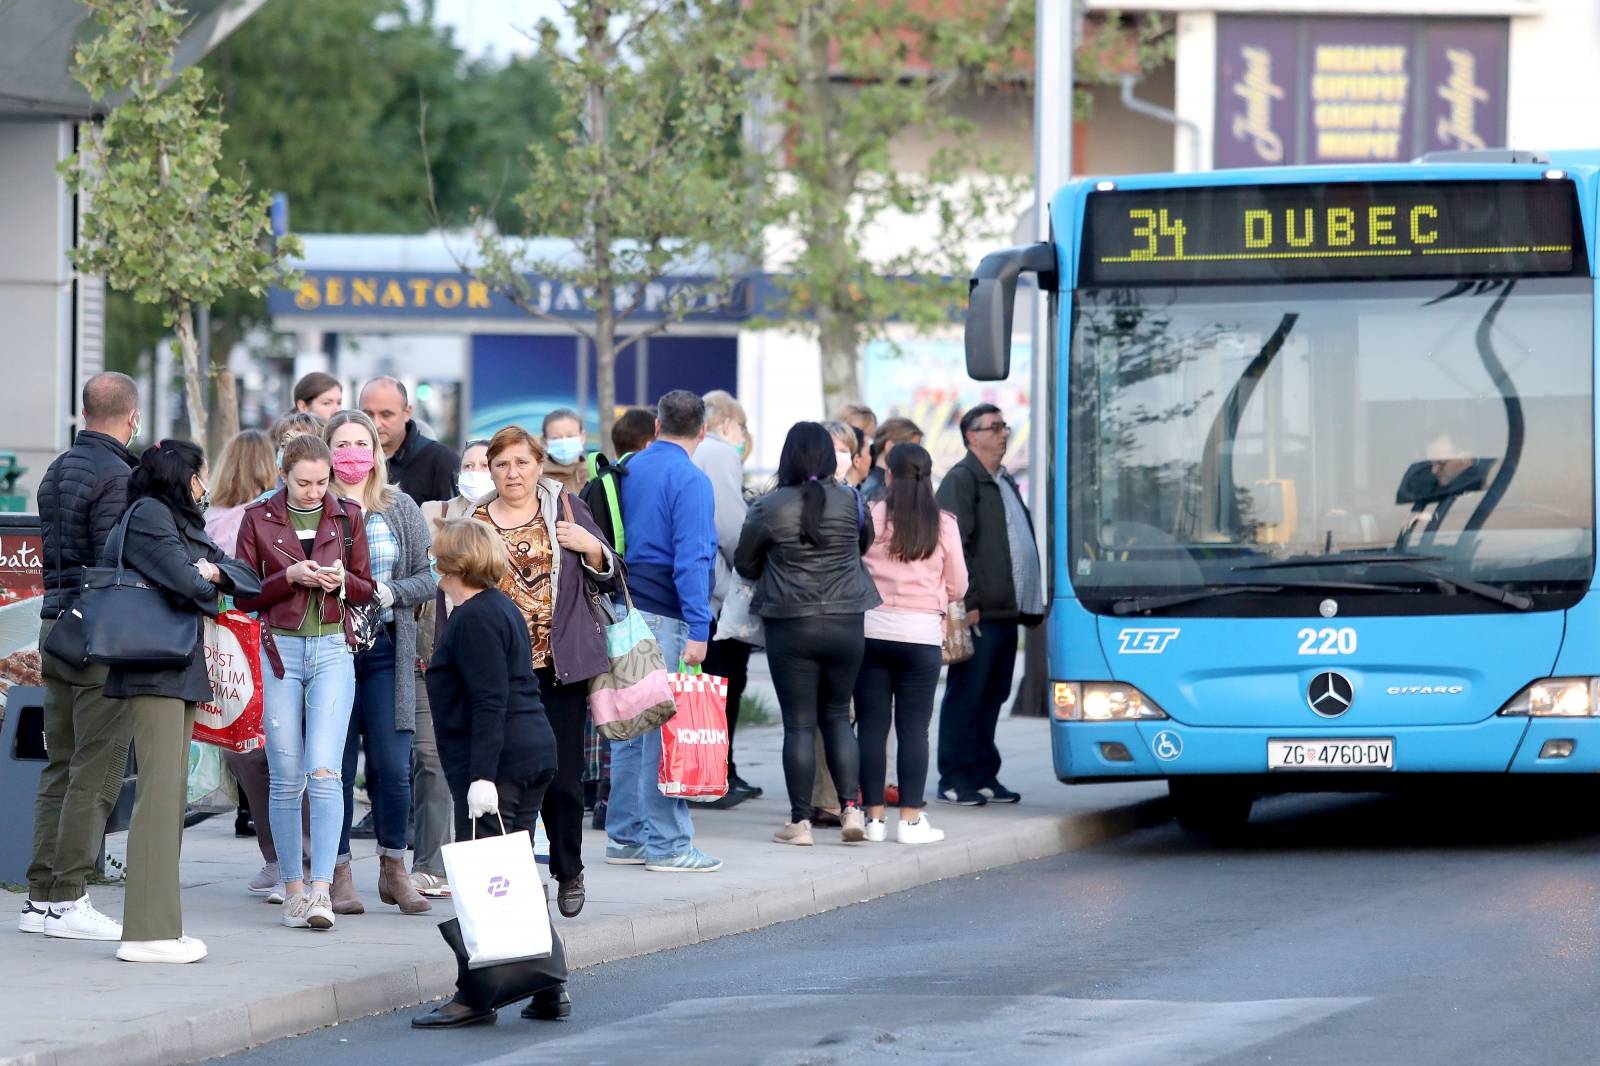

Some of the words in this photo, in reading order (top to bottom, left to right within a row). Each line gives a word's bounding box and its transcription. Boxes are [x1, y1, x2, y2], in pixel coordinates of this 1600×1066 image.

[1130, 208, 1186, 259] 34
[1245, 205, 1438, 248] DUBEC
[294, 276, 492, 310] SENATOR
[1118, 628, 1181, 654] ZET
[1297, 627, 1357, 655] 220
[1386, 685, 1463, 696] CITARO
[677, 727, 727, 745] KONZUM
[1283, 745, 1305, 764] ZG
